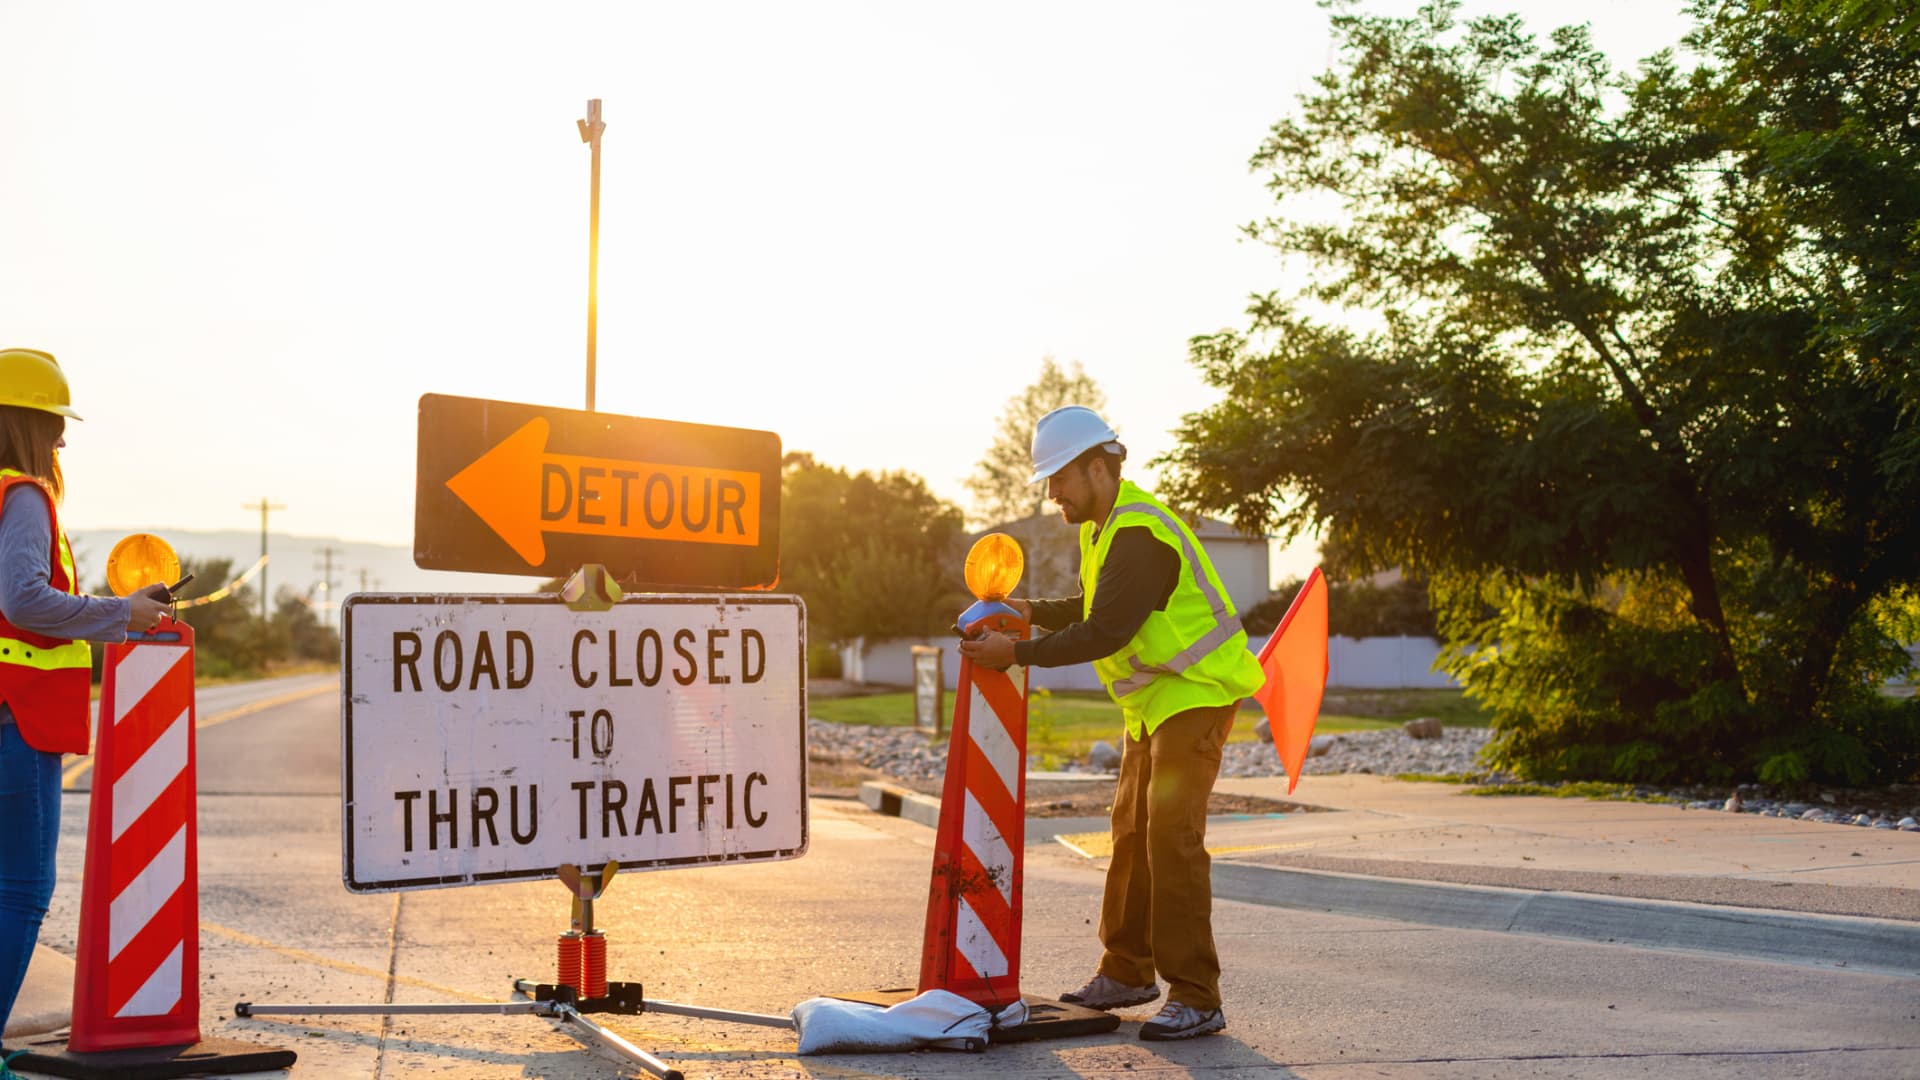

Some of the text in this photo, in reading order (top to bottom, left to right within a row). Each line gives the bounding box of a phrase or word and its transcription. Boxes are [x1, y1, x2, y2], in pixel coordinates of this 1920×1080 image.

[541, 463, 746, 536] DETOUR
[393, 627, 766, 692] ROAD CLOSED
[569, 708, 614, 759] TO
[395, 771, 768, 852] THRU TRAFFIC
